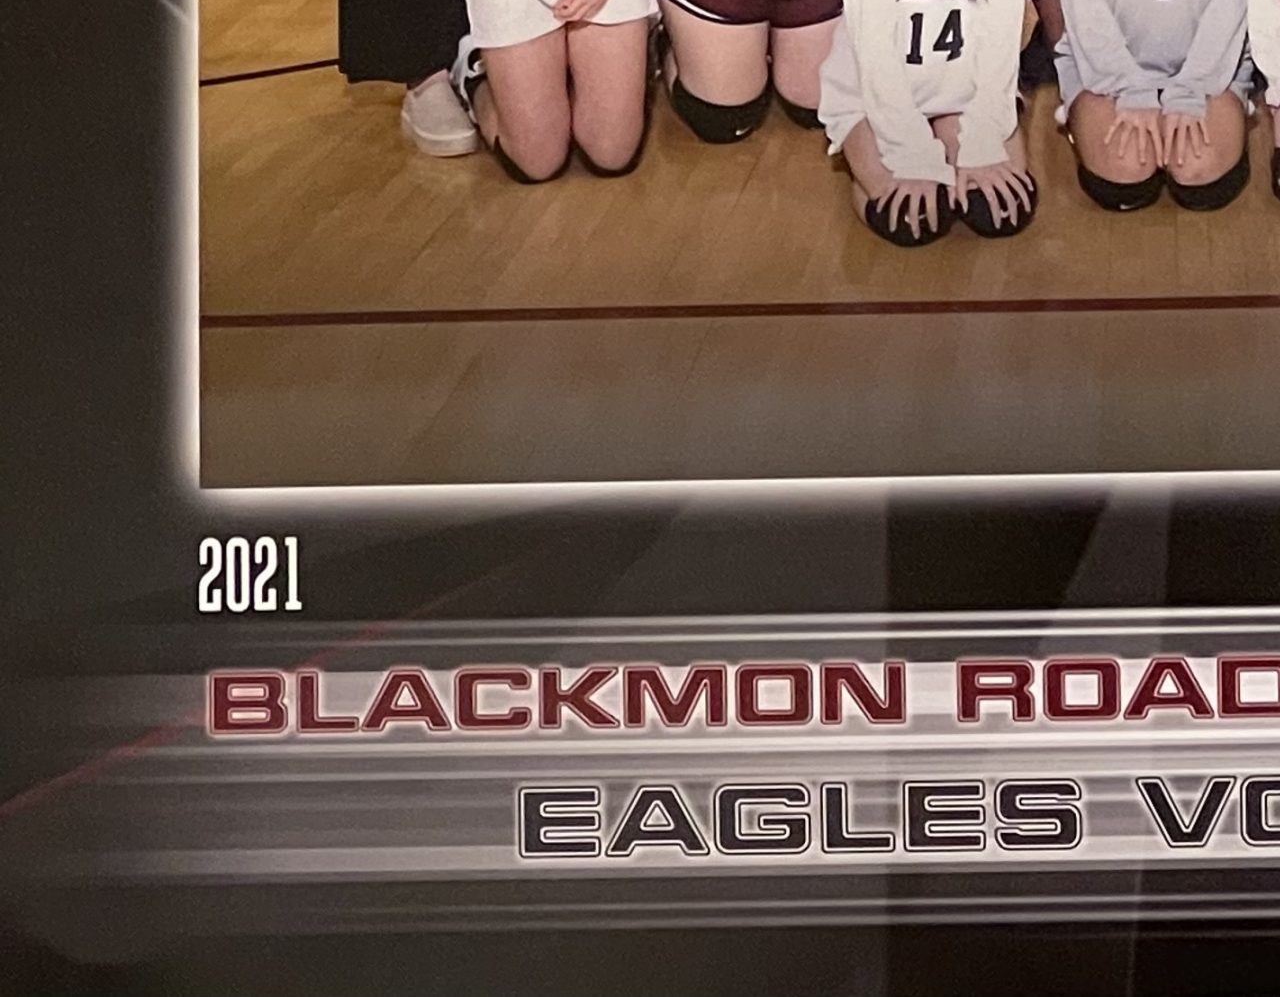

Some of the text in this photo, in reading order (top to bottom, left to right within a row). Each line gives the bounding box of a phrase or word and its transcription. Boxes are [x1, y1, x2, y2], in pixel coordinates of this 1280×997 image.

[905, 8, 964, 65] 14
[198, 536, 303, 613] 2021
[209, 662, 907, 734] BLACKMON
[517, 778, 1083, 859] EAGLES
